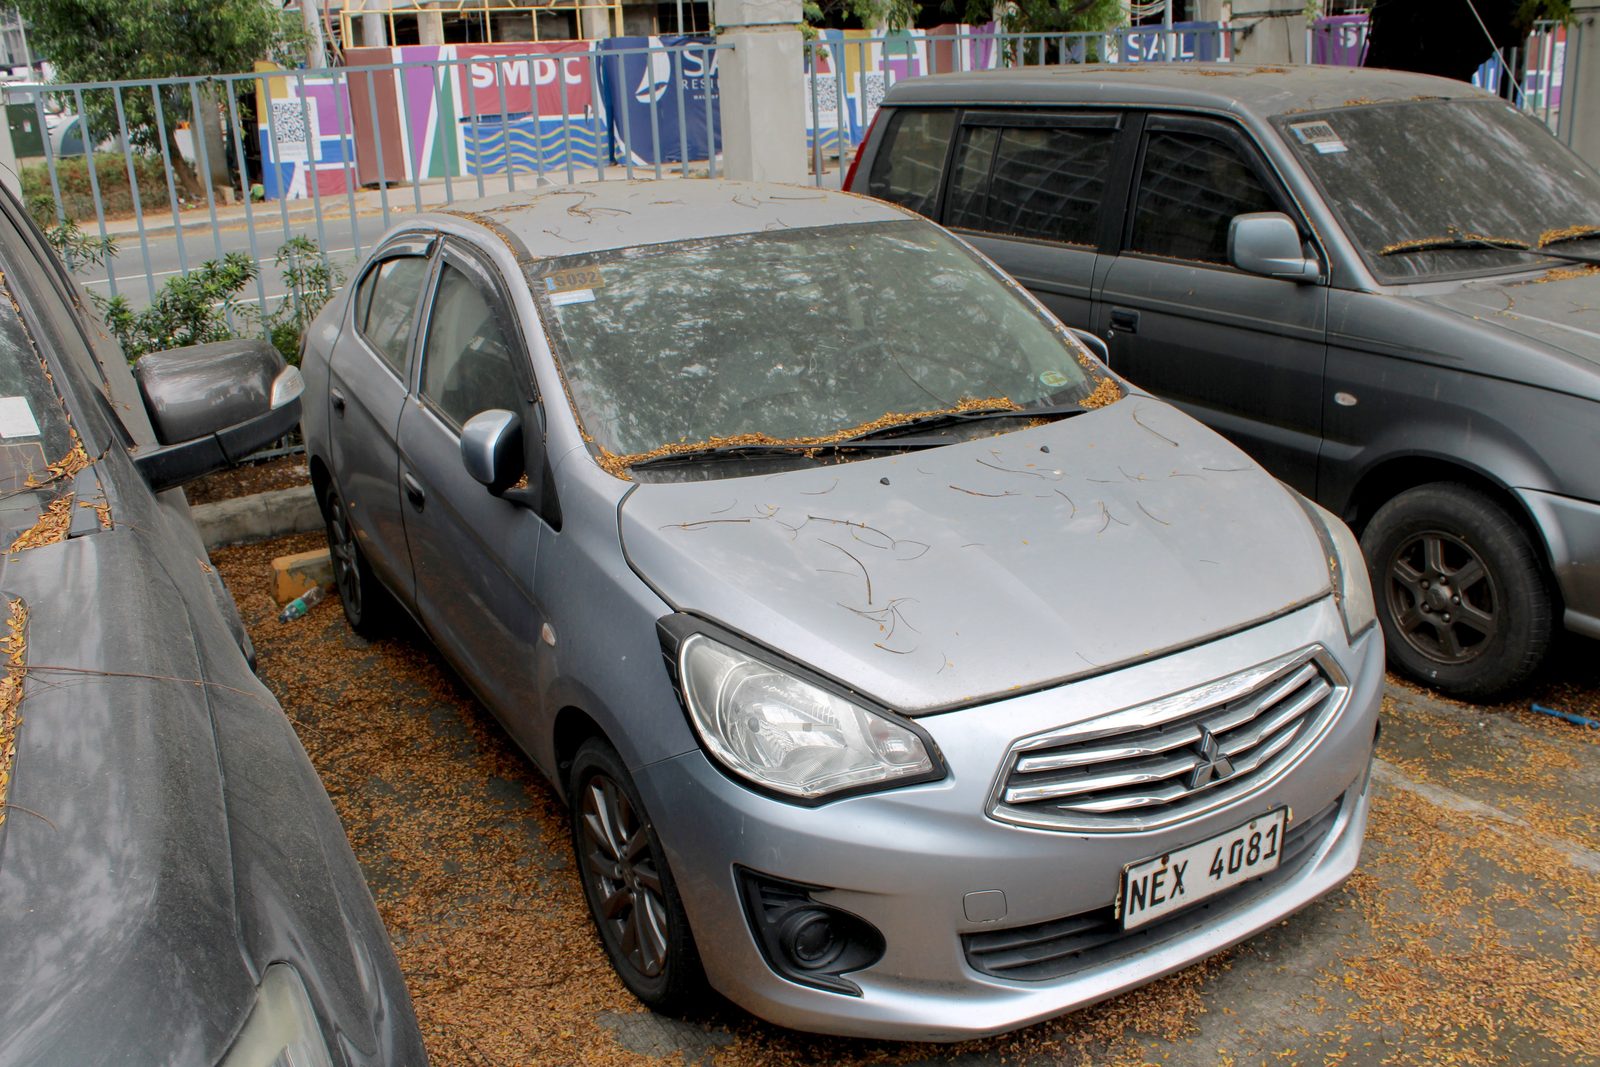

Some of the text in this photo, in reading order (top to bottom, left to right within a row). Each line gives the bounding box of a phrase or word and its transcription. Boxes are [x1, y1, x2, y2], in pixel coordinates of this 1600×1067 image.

[470, 54, 582, 88] SMDC
[1129, 823, 1279, 915] NEX 4081
